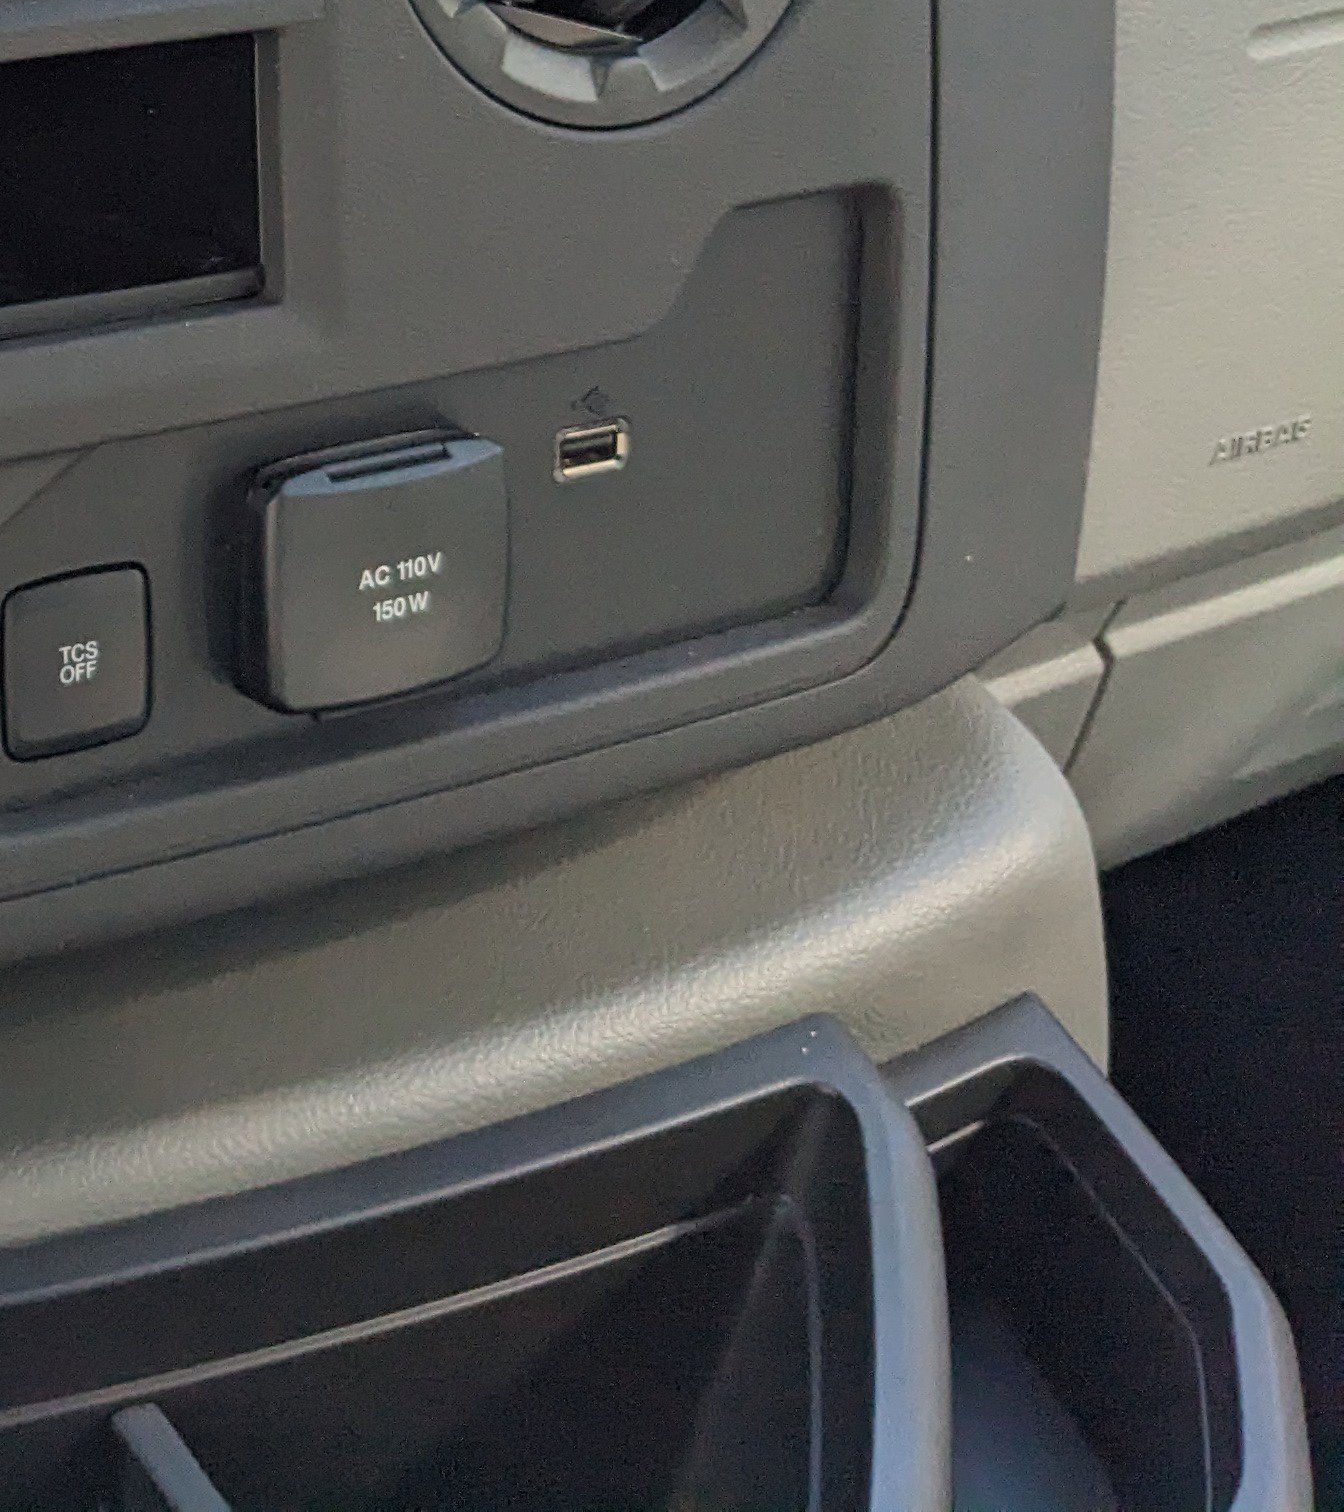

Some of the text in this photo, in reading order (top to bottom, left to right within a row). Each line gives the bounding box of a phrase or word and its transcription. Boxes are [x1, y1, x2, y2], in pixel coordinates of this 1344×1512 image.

[358, 550, 442, 590] AC 110V
[58, 640, 99, 664] TCS
[59, 659, 97, 685] OFF
